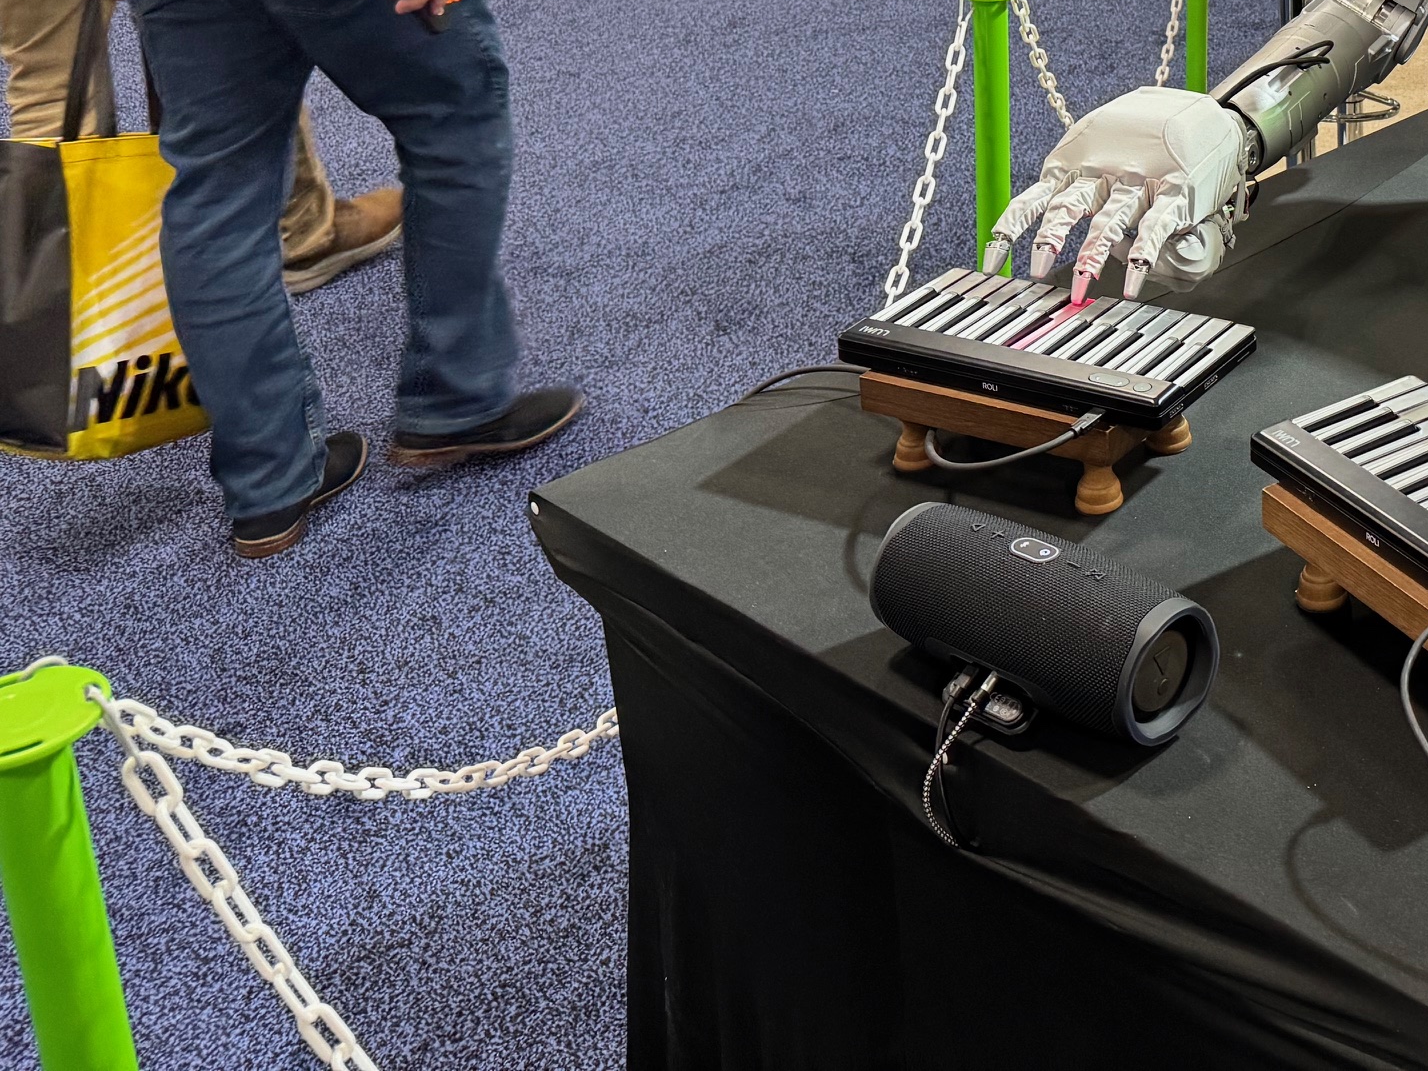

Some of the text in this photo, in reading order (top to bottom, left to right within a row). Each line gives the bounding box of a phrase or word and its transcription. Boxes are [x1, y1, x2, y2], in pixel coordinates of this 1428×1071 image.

[858, 325, 891, 337] LUMI
[74, 352, 201, 432] Nik
[982, 382, 998, 392] ROLI
[1271, 429, 1301, 448] LUMI
[1365, 531, 1380, 547] ROLI
